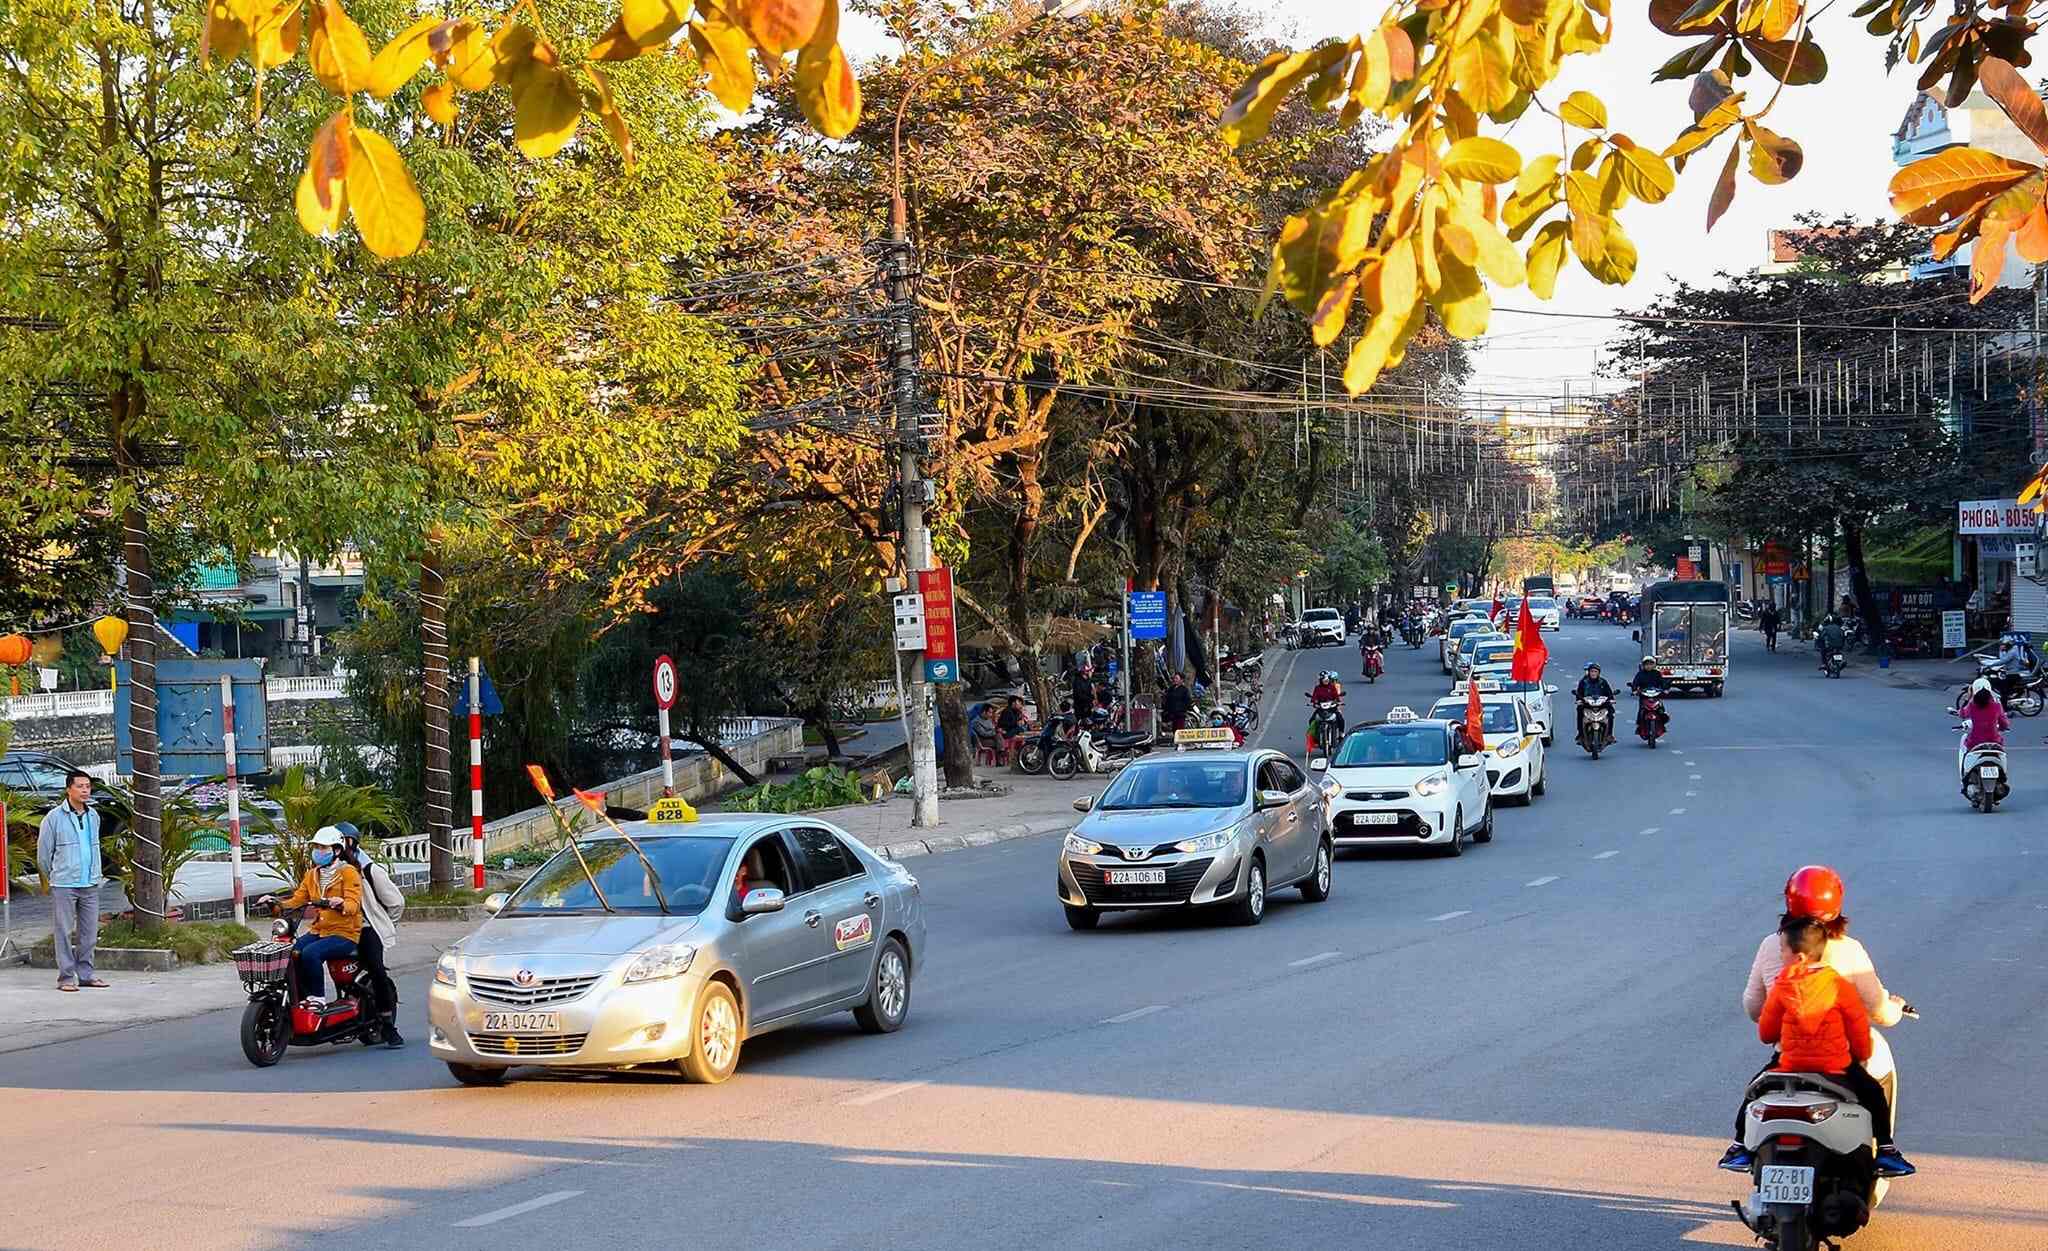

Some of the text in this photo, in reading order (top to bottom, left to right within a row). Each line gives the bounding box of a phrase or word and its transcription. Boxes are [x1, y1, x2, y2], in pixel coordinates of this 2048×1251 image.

[1962, 502, 1983, 528] PHỞ
[661, 670, 672, 692] 13
[660, 801, 680, 809] TAXI
[657, 809, 682, 821] 828
